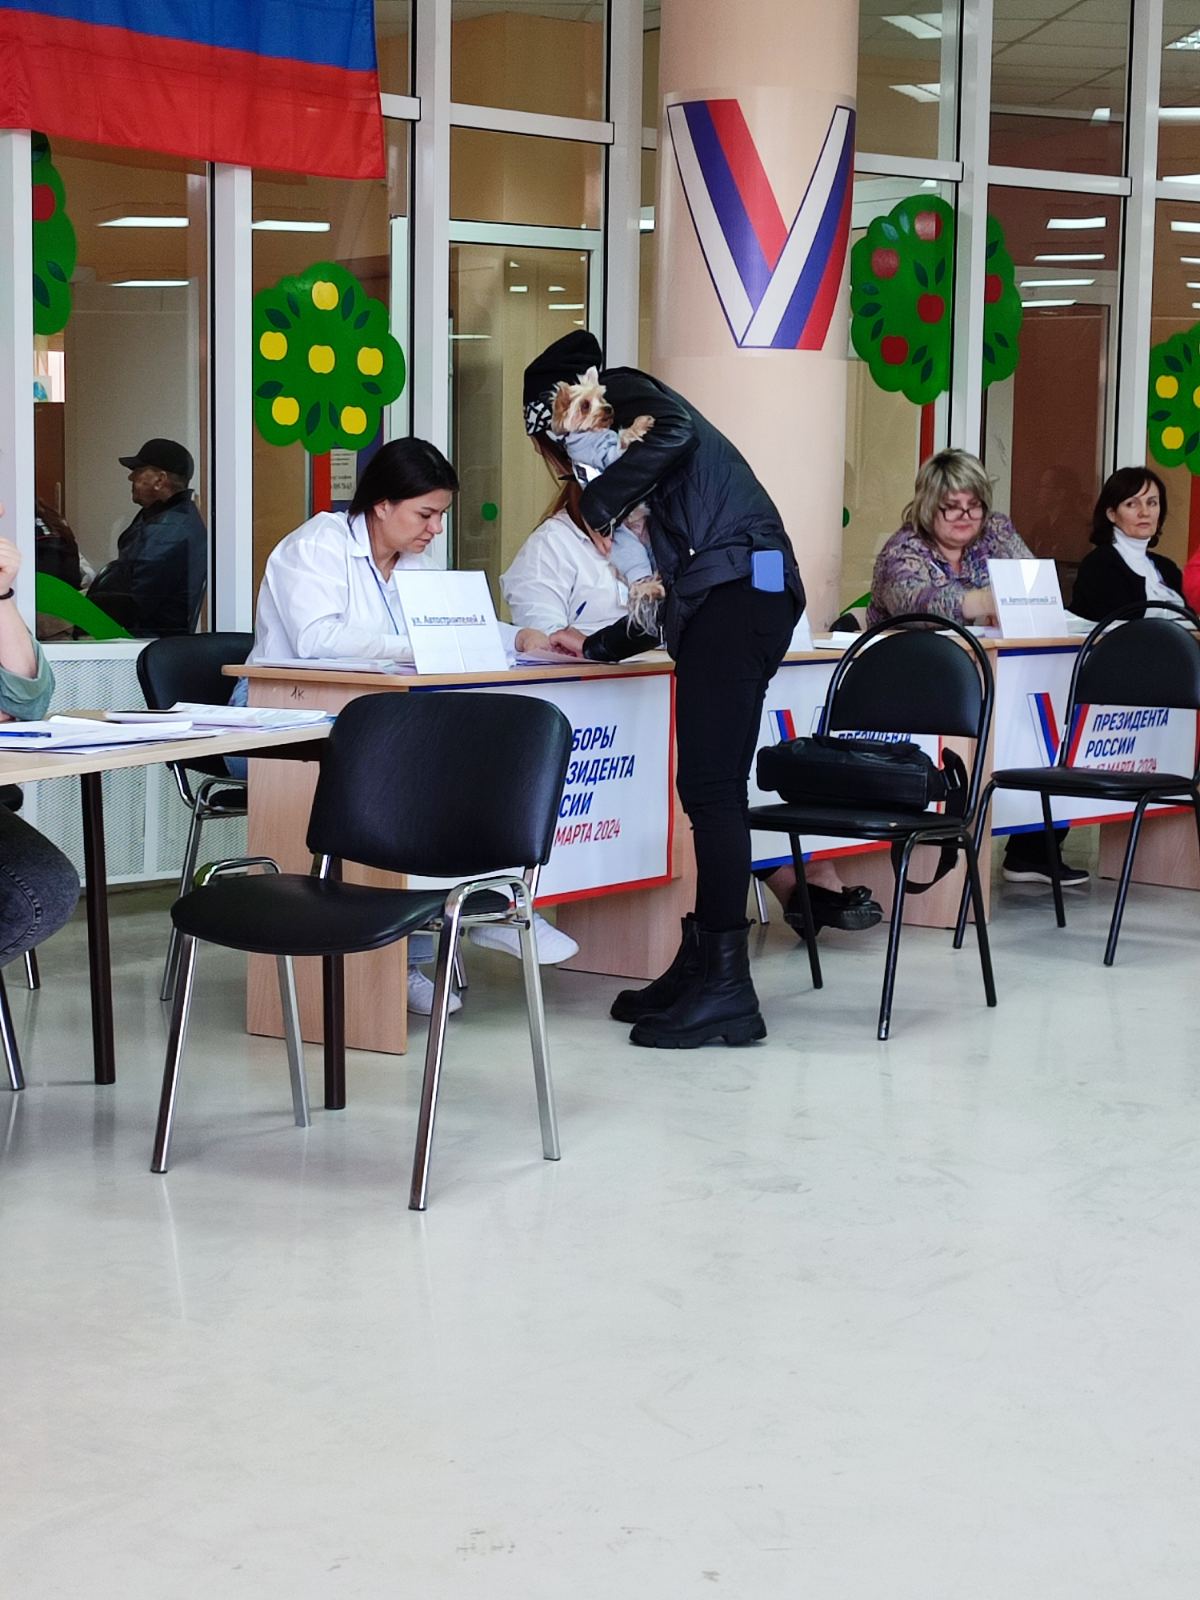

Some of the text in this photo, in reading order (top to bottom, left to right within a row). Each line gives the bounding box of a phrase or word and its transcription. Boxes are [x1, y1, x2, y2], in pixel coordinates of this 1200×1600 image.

[1092, 708, 1169, 732] ПРЕЗИДЕНТА
[571, 725, 618, 752] БОРЫ
[1085, 736, 1136, 758] РОССИИ
[565, 755, 636, 786] ЗИДЕНТА
[559, 791, 594, 819] СИИ
[553, 818, 621, 847] МАРТА 2024
